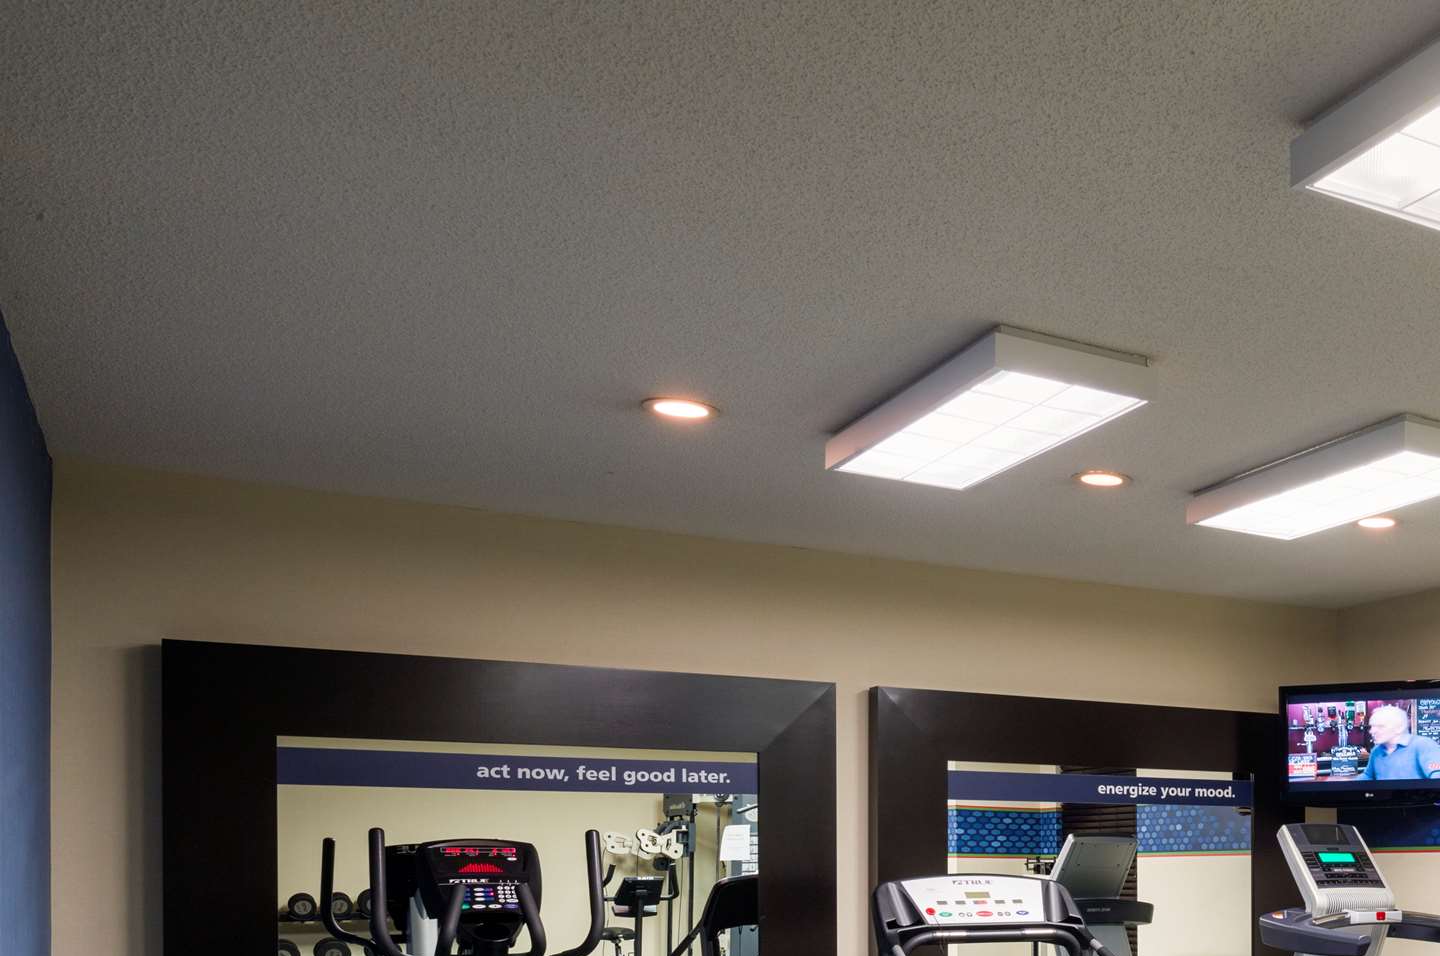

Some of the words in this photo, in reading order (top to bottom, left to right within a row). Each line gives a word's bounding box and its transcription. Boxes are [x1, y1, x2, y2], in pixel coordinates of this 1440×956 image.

[477, 765, 510, 778] act
[517, 768, 569, 782] now,
[577, 765, 616, 781] feel
[623, 768, 675, 785] good
[682, 768, 731, 784] later.
[1098, 783, 1157, 798] energize
[1161, 787, 1191, 799] your
[1195, 786, 1236, 798] mood.
